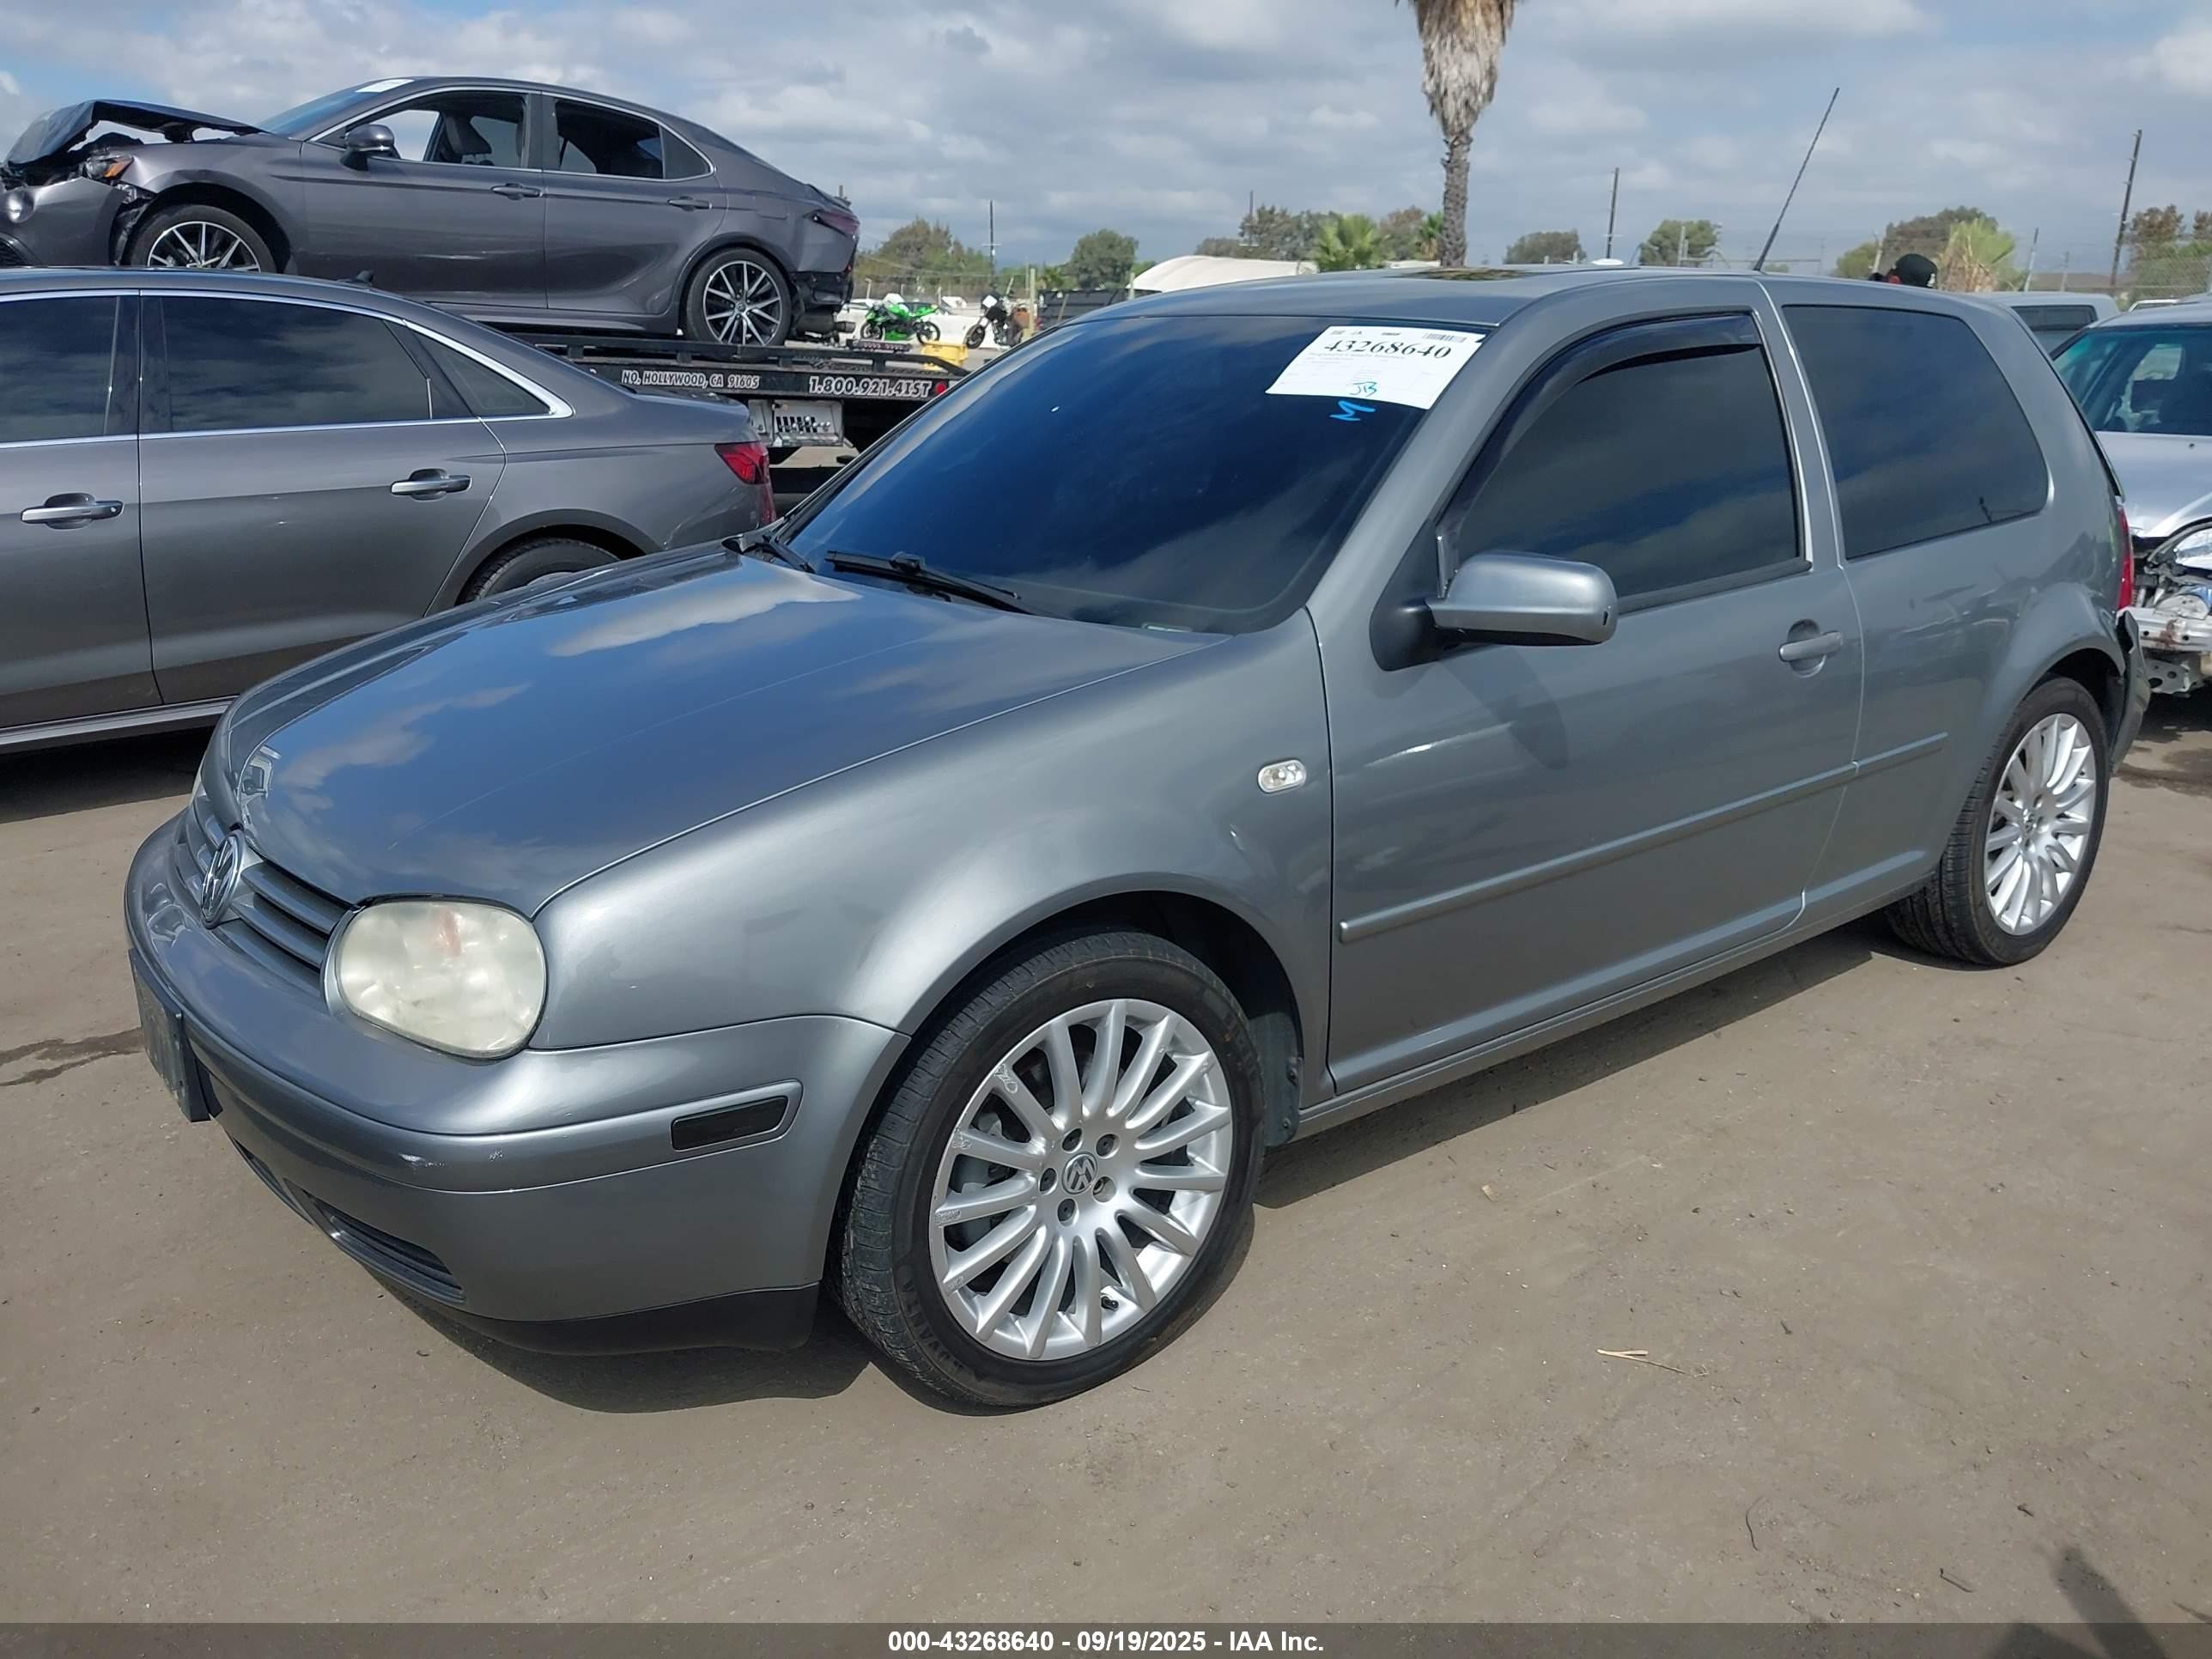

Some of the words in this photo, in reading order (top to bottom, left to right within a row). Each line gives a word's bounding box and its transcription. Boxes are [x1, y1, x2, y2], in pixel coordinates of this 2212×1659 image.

[1324, 340, 1452, 359] 43268640
[621, 369, 641, 385] NO.
[642, 371, 708, 389] HOLLYWOOD,
[709, 374, 724, 387] CA
[727, 374, 760, 389] 91605
